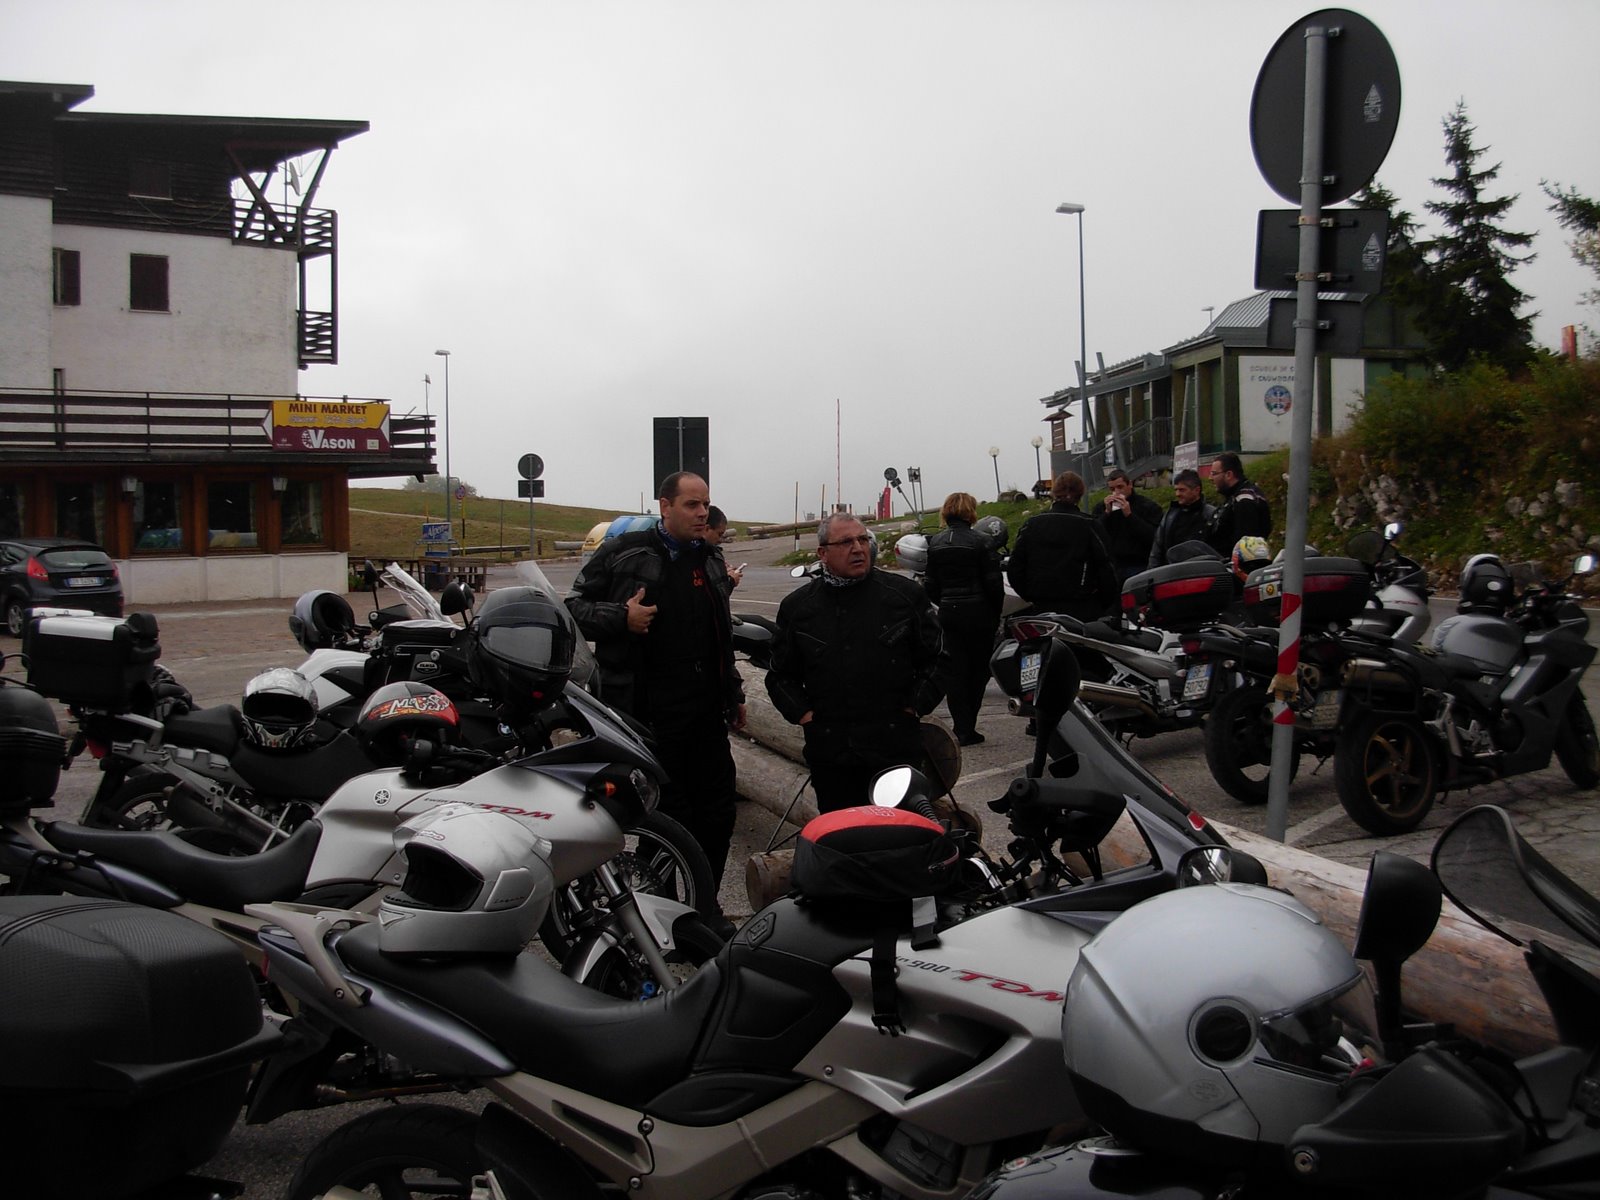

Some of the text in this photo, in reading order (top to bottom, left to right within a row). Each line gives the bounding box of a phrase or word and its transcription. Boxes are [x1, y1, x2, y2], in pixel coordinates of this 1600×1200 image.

[288, 402, 367, 415] MINI MARKET
[306, 429, 356, 449] VASON
[480, 803, 556, 820] TDM
[908, 960, 951, 973] 900
